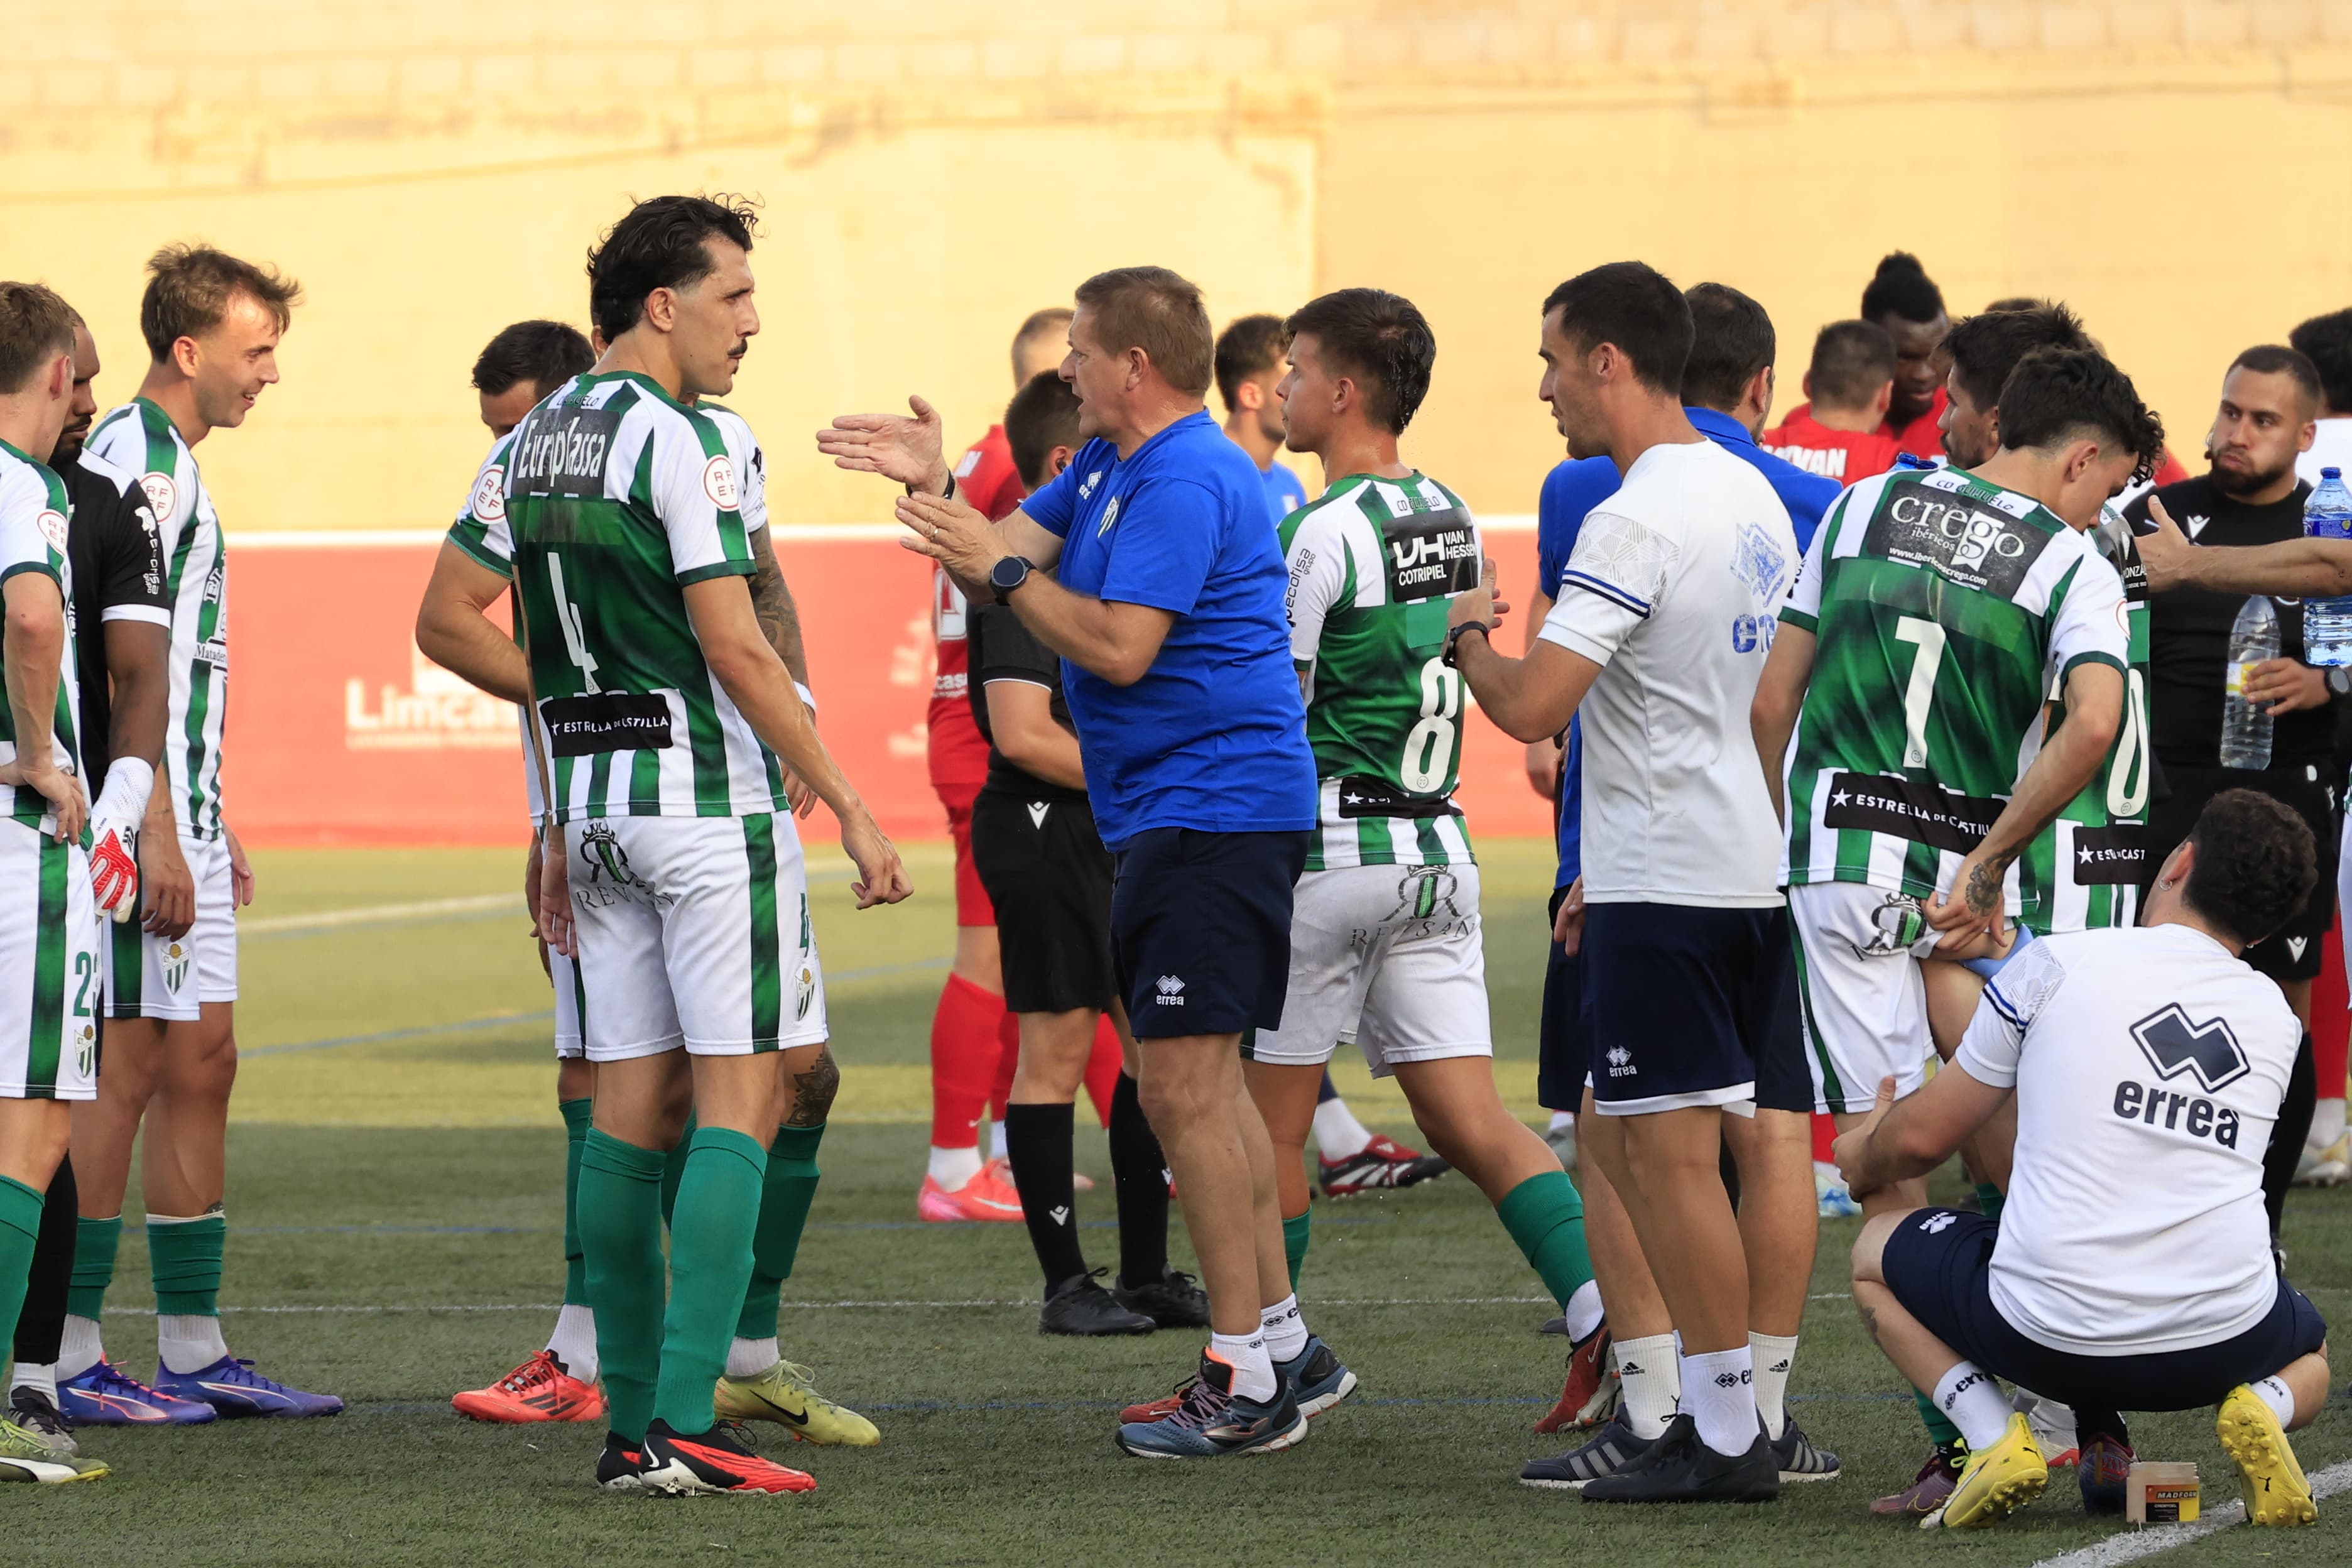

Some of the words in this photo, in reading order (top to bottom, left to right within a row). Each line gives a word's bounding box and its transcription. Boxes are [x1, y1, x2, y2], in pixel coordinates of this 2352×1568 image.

[517, 416, 606, 487] Eurplassa
[1444, 530, 1466, 545] VAN
[1890, 496, 2025, 560] crego
[1911, 526, 1956, 552] ibéricos
[1303, 553, 1316, 575] grupo
[1446, 544, 1476, 560] HESSEN
[1888, 546, 1988, 587] www.ibericoscrego.com
[1398, 564, 1447, 587] COTRIPIEL
[547, 552, 602, 695] 4
[1895, 615, 1947, 770] 7
[1400, 656, 1459, 793] 8
[1856, 793, 1931, 822] ESTRELLA
[1933, 813, 1946, 822] DE
